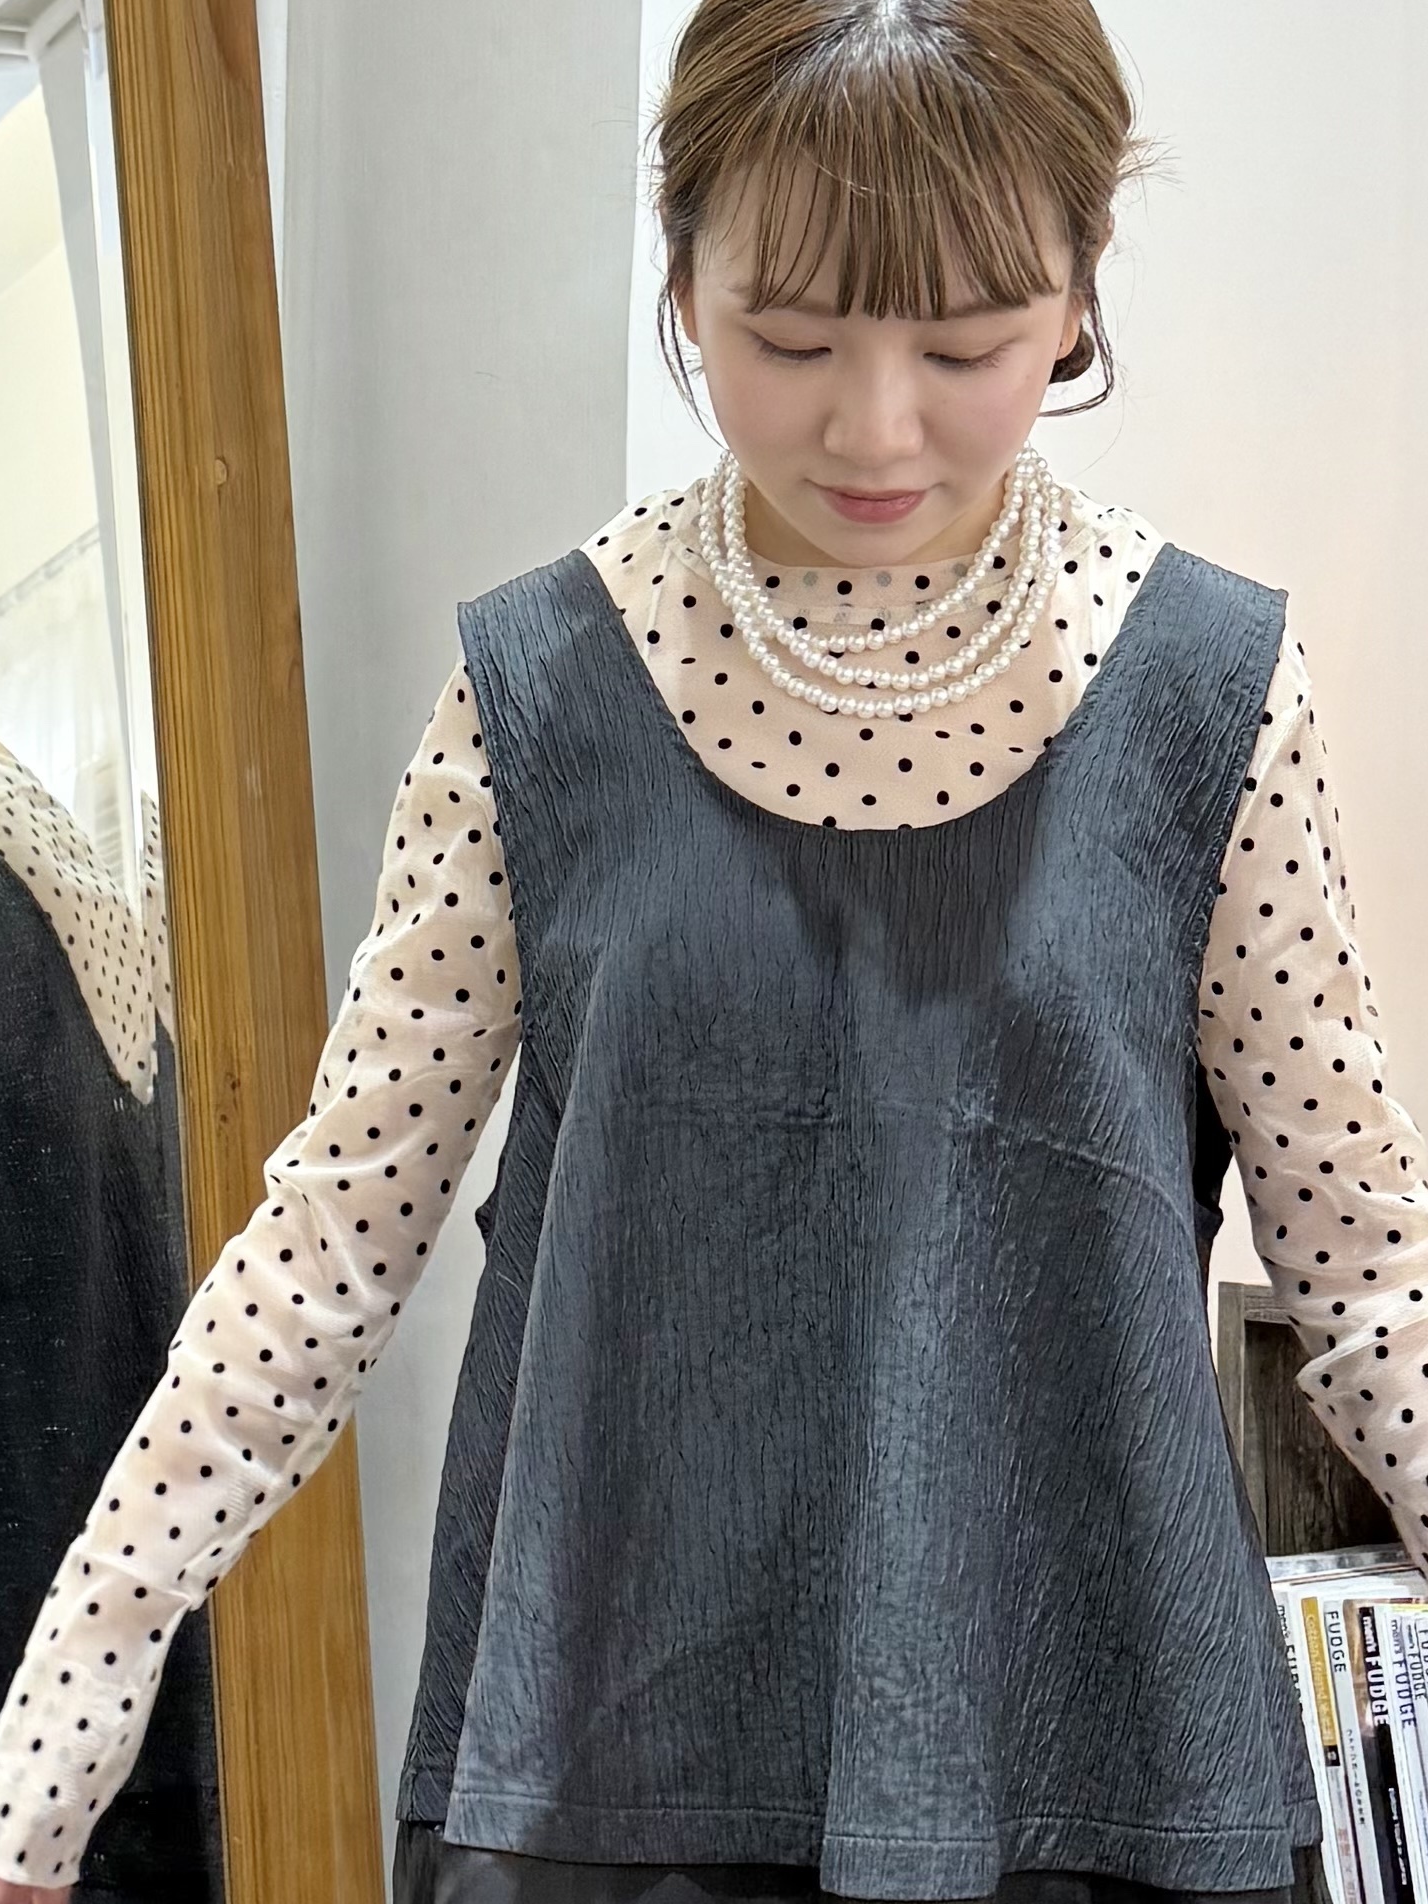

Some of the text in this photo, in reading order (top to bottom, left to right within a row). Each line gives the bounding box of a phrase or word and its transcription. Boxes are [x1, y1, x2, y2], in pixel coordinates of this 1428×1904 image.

[1325, 1610, 1347, 1673] FUDGE
[1362, 1616, 1389, 1726] men's FUDGE
[1391, 1619, 1417, 1729] men's FUDGE
[1408, 1653, 1425, 1700] FUDGE
